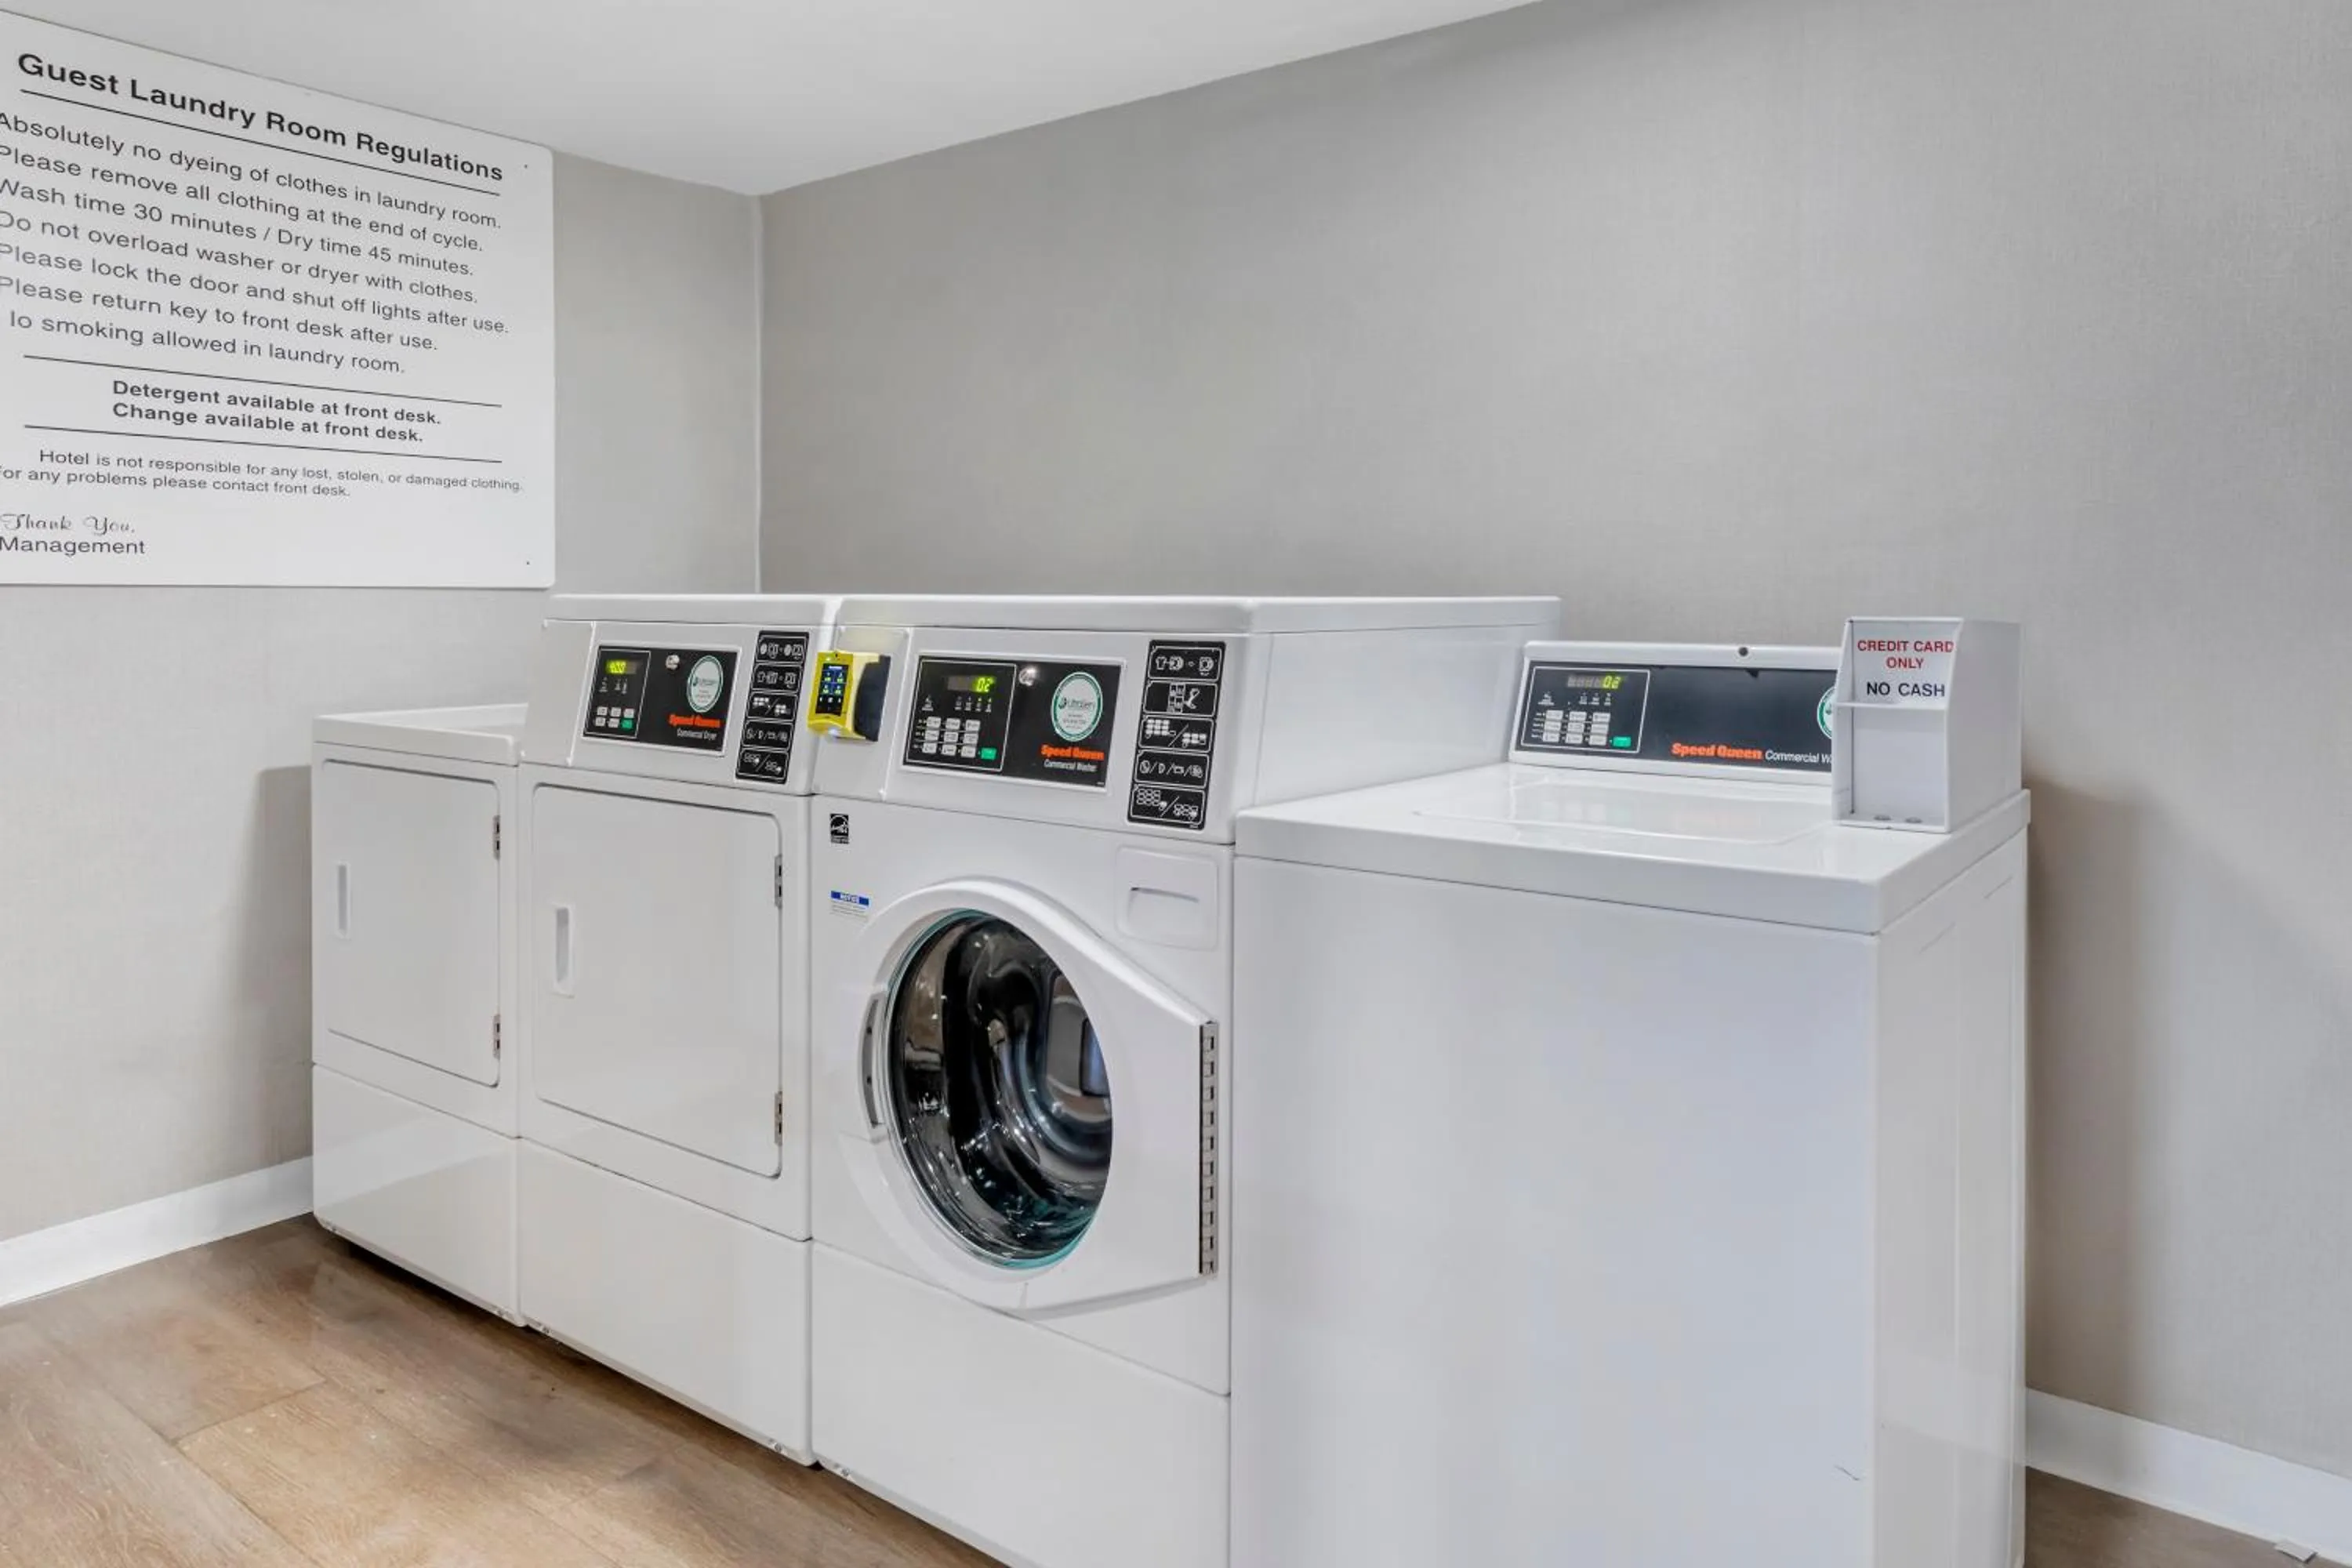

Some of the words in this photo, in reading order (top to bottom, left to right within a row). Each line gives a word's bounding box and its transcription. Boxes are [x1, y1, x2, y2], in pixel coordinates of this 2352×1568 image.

[18, 53, 118, 95] Guest
[131, 79, 256, 129] Laundry
[267, 111, 346, 144] Room
[357, 132, 503, 181] Regulations
[0, 111, 125, 158] Absolutely
[132, 143, 164, 162] no
[169, 151, 242, 182] dyeing
[249, 166, 270, 184] of
[276, 173, 347, 199] clothes
[354, 185, 372, 203] in
[376, 191, 447, 223] laundry
[452, 209, 501, 230] room.
[91, 167, 178, 194] remove
[184, 183, 210, 202] all
[217, 187, 300, 221] clothing
[306, 208, 325, 223] at
[332, 211, 361, 229] the
[368, 220, 404, 237] end
[410, 227, 426, 241] of
[432, 230, 482, 251] cycle.
[73, 191, 126, 216] time
[132, 202, 164, 223] 30
[169, 212, 258, 240] minutes
[263, 225, 273, 242] /
[277, 224, 314, 252] Dry
[320, 236, 361, 256] time
[368, 245, 391, 262] 45
[397, 252, 474, 277] minutes.
[40, 220, 81, 241] not
[87, 228, 189, 259] overload
[194, 246, 276, 272] washer
[280, 261, 303, 276] or
[306, 263, 361, 286] dryer
[364, 272, 404, 292] with
[408, 278, 478, 304] clothes.
[90, 256, 139, 281] lock
[145, 266, 183, 287] the
[188, 273, 241, 296] door
[245, 285, 285, 302] and
[292, 291, 336, 310] shut
[339, 296, 368, 314] off
[372, 299, 423, 325] lights
[426, 308, 468, 328] after
[473, 317, 509, 334] use.
[91, 292, 162, 314] return
[169, 301, 209, 325] key
[215, 308, 235, 324] to
[241, 309, 291, 332] front
[295, 318, 345, 339] desk
[349, 325, 395, 345] after
[398, 334, 438, 350] use.
[41, 318, 144, 347] smoking
[151, 328, 238, 355] allowed
[241, 338, 263, 358] in
[268, 342, 346, 372] laundry
[350, 352, 405, 374] room.
[112, 379, 221, 405] Detergent
[225, 394, 316, 414] available
[320, 401, 340, 416] at
[343, 401, 390, 421] front
[393, 408, 442, 425] desk.
[112, 401, 200, 426] Change
[204, 412, 296, 433] available
[299, 419, 320, 435] at
[323, 420, 370, 439] front
[374, 425, 423, 444] desk.
[0, 465, 23, 481] or
[27, 470, 62, 485] any
[66, 470, 148, 487] problems
[151, 474, 209, 490] please
[212, 480, 270, 493] contact
[273, 480, 308, 495] front
[310, 482, 351, 497] desk.
[40, 449, 89, 465] Hotel
[96, 453, 111, 466] is
[116, 456, 143, 469] not
[149, 459, 241, 474] responsible
[246, 463, 267, 476] for
[270, 466, 298, 479] any
[302, 466, 332, 481] lost,
[337, 469, 383, 485] stolen,
[388, 474, 404, 484] or
[406, 474, 468, 488] damaged
[470, 477, 523, 491] clothing.
[0, 535, 145, 557] Management
[2, 514, 72, 530] Thank
[83, 515, 135, 536] You.
[1857, 640, 1909, 652] CREDIT
[1914, 641, 1955, 652] CARD
[1886, 657, 1924, 669] ONLY
[1867, 681, 1890, 695] NO
[1898, 683, 1945, 697] CASH
[1671, 742, 1716, 757] Speed
[1717, 745, 1763, 760] Queen
[1765, 750, 1819, 764] Commercial
